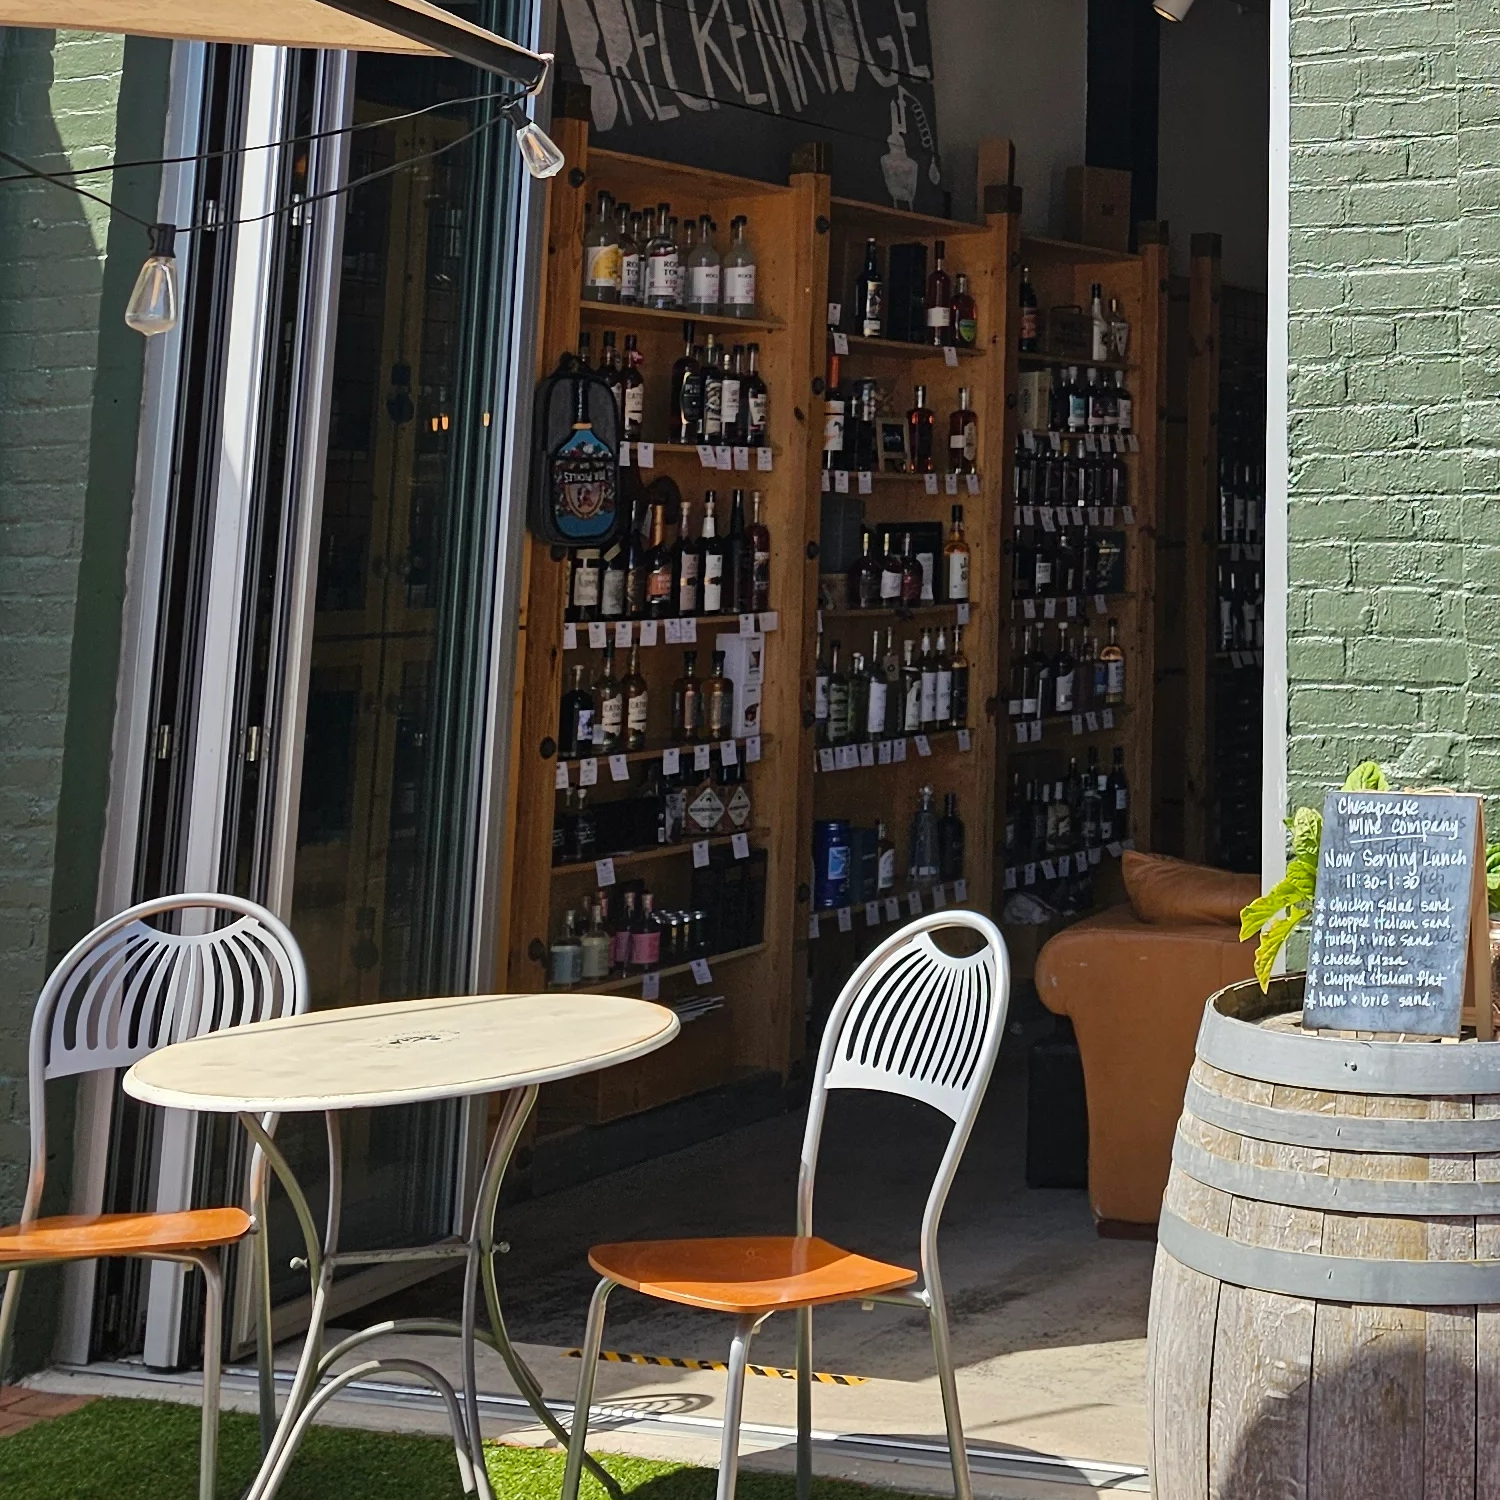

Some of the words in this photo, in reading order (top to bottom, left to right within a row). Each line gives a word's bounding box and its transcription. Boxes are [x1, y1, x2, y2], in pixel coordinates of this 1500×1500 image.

[1337, 796, 1419, 820] Chesapeake
[1325, 848, 1355, 868] Now
[1362, 849, 1417, 876] Serving
[1423, 849, 1467, 866] Lunch
[1324, 931, 1358, 953] turkey
[1323, 953, 1363, 966] cheese
[1367, 952, 1408, 971] pizza
[1416, 970, 1447, 986] flat
[1319, 991, 1347, 1007] ham
[1361, 991, 1389, 1007] brie
